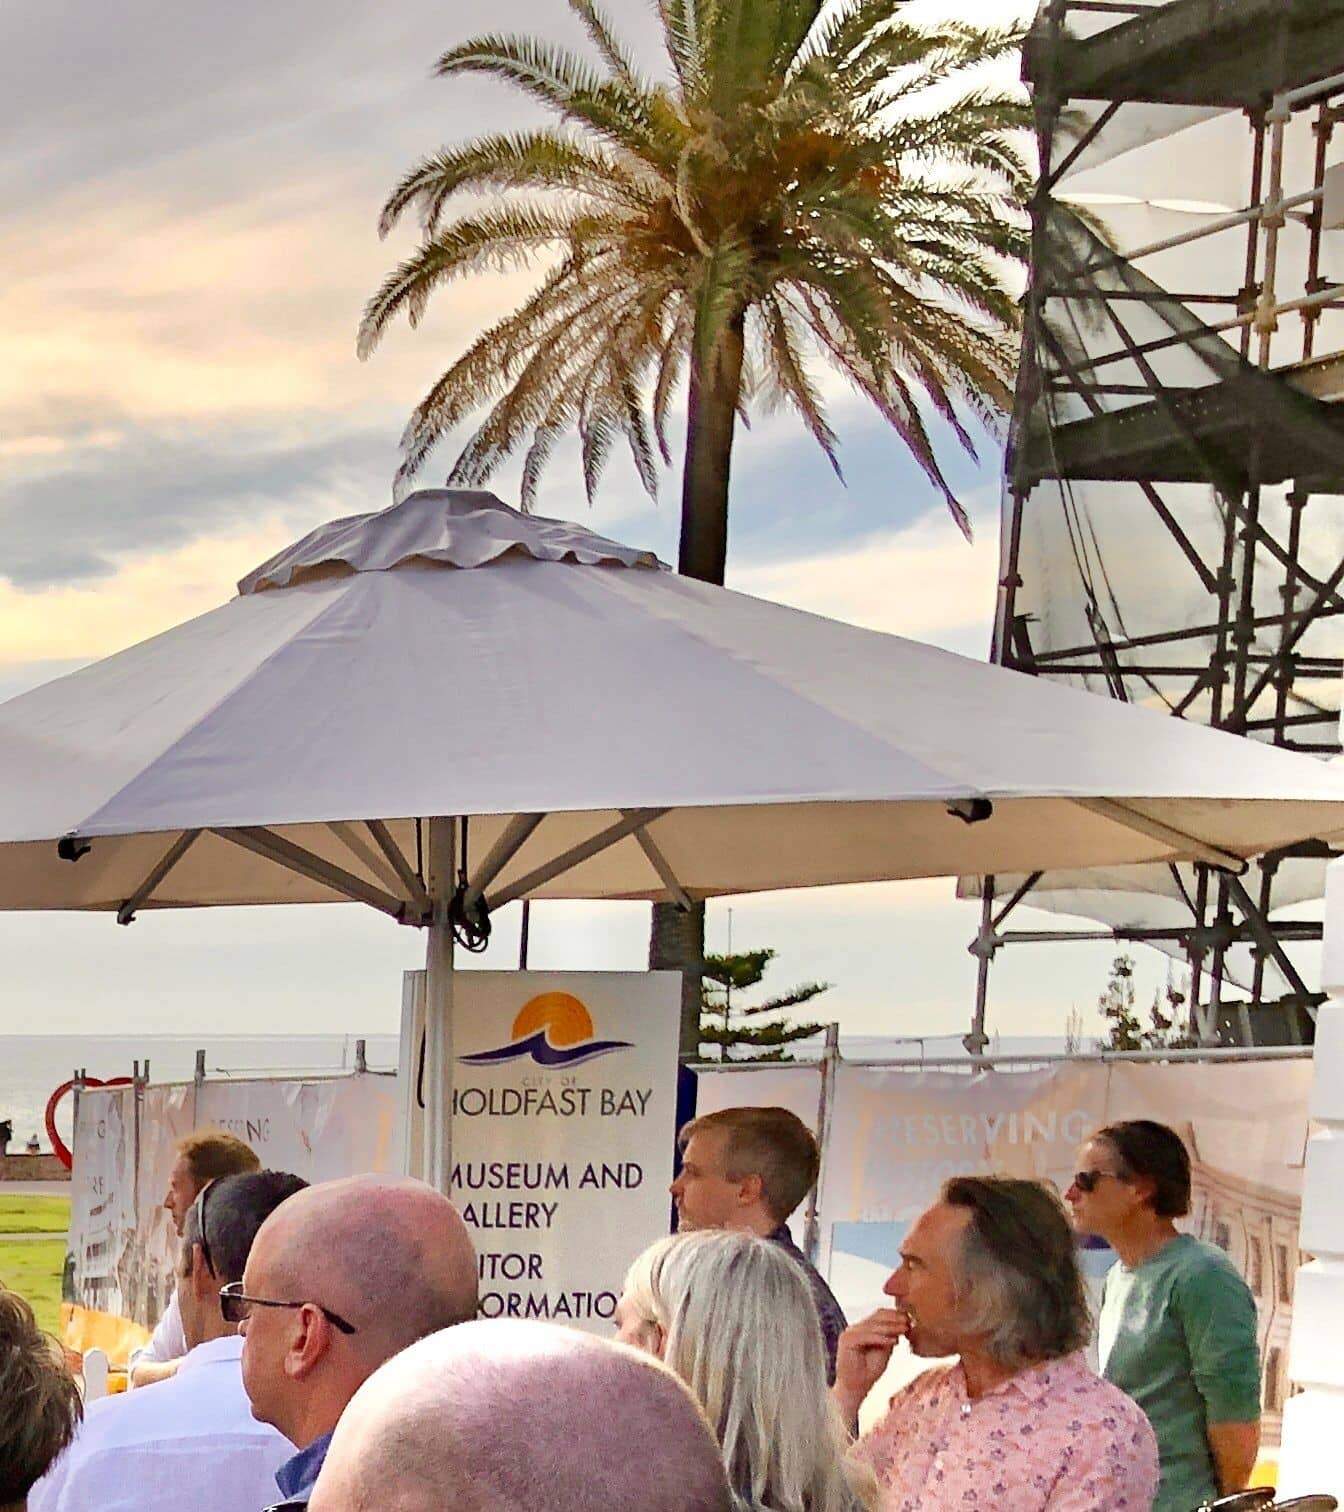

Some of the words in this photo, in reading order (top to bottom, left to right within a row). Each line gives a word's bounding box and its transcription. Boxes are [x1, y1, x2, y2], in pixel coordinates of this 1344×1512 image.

[600, 1088, 653, 1117] BAY
[579, 1162, 643, 1190] AND
[463, 1201, 559, 1229] ALLERY
[478, 1253, 544, 1280] ITOR
[478, 1290, 623, 1320] ORMATIO
